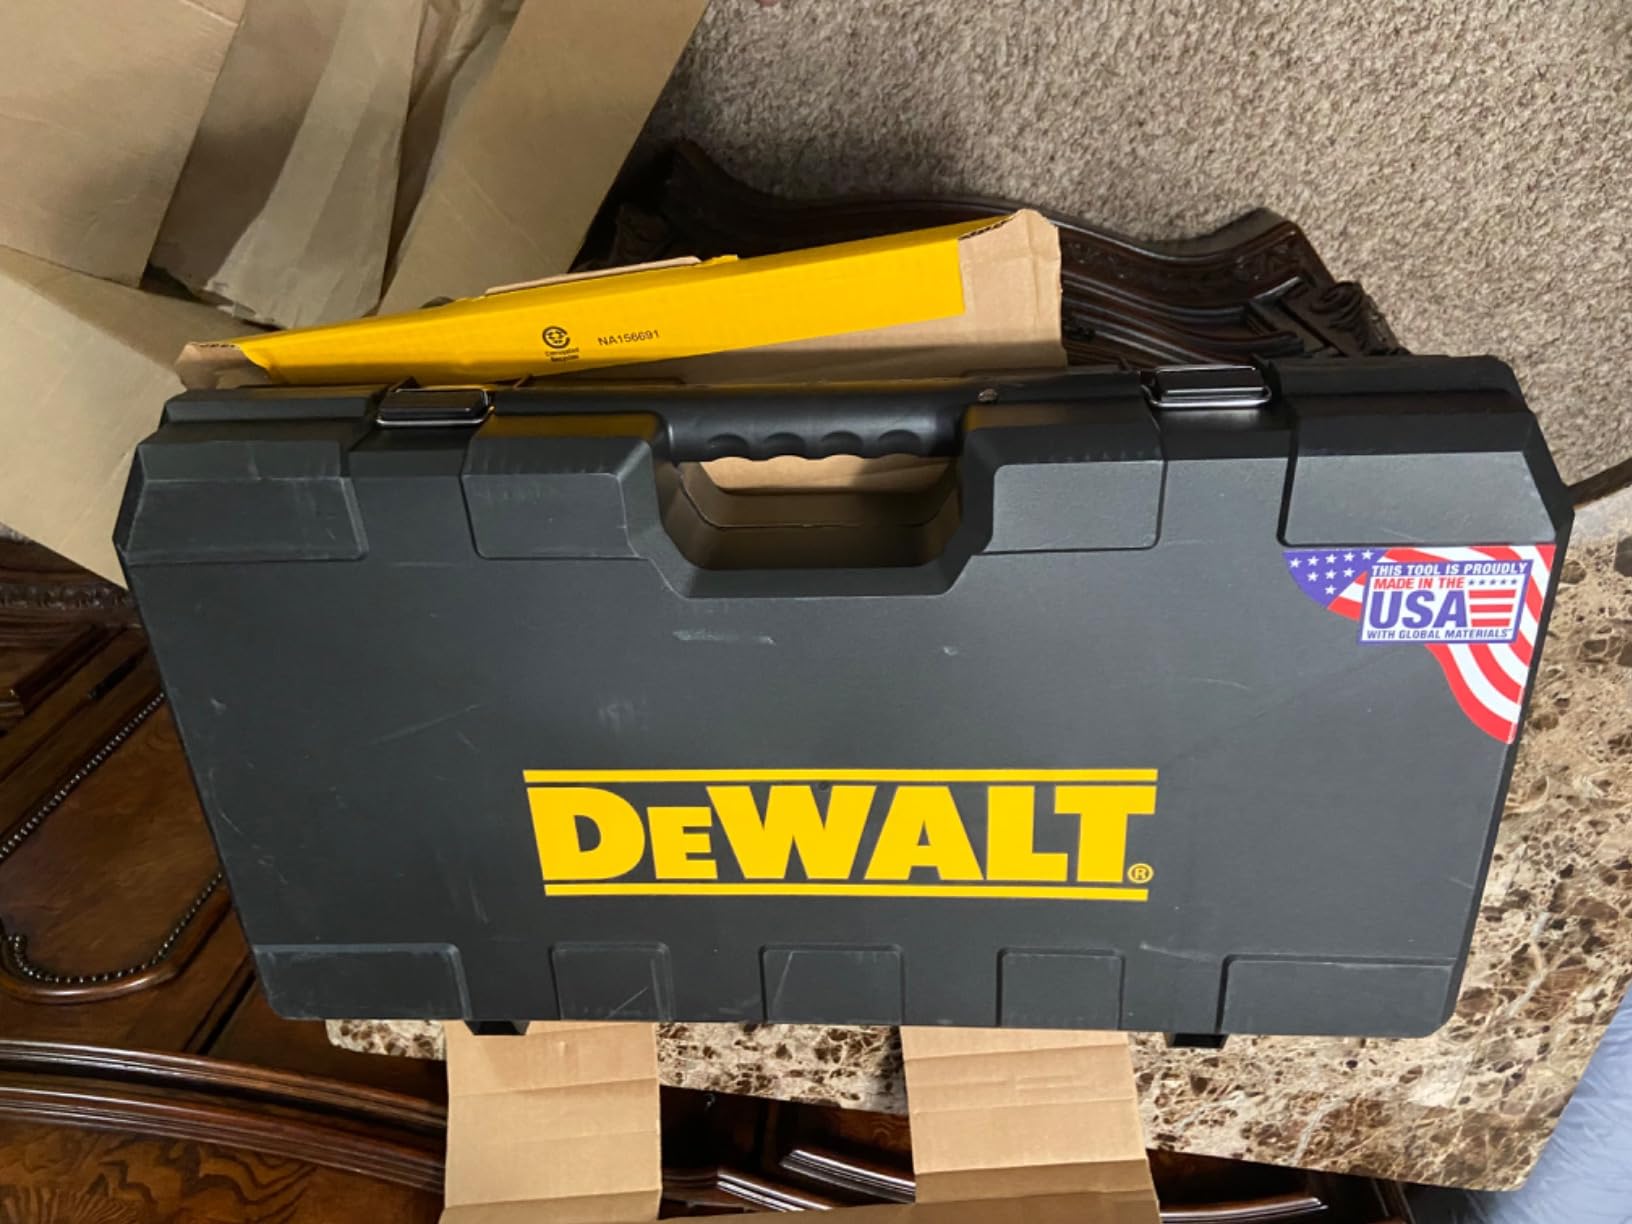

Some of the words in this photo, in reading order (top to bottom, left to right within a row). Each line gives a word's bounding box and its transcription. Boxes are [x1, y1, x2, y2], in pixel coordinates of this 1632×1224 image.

[1372, 565, 1402, 576] THIS
[1407, 564, 1441, 576] TOOL
[1446, 563, 1459, 575] IS
[1464, 562, 1528, 574] PROUDLY
[1373, 578, 1414, 589] MADE
[1419, 578, 1433, 589] IN
[1438, 577, 1465, 588] THE
[1369, 590, 1468, 629] USA
[1367, 630, 1395, 639] WITH
[1400, 629, 1440, 639] GLOBAL
